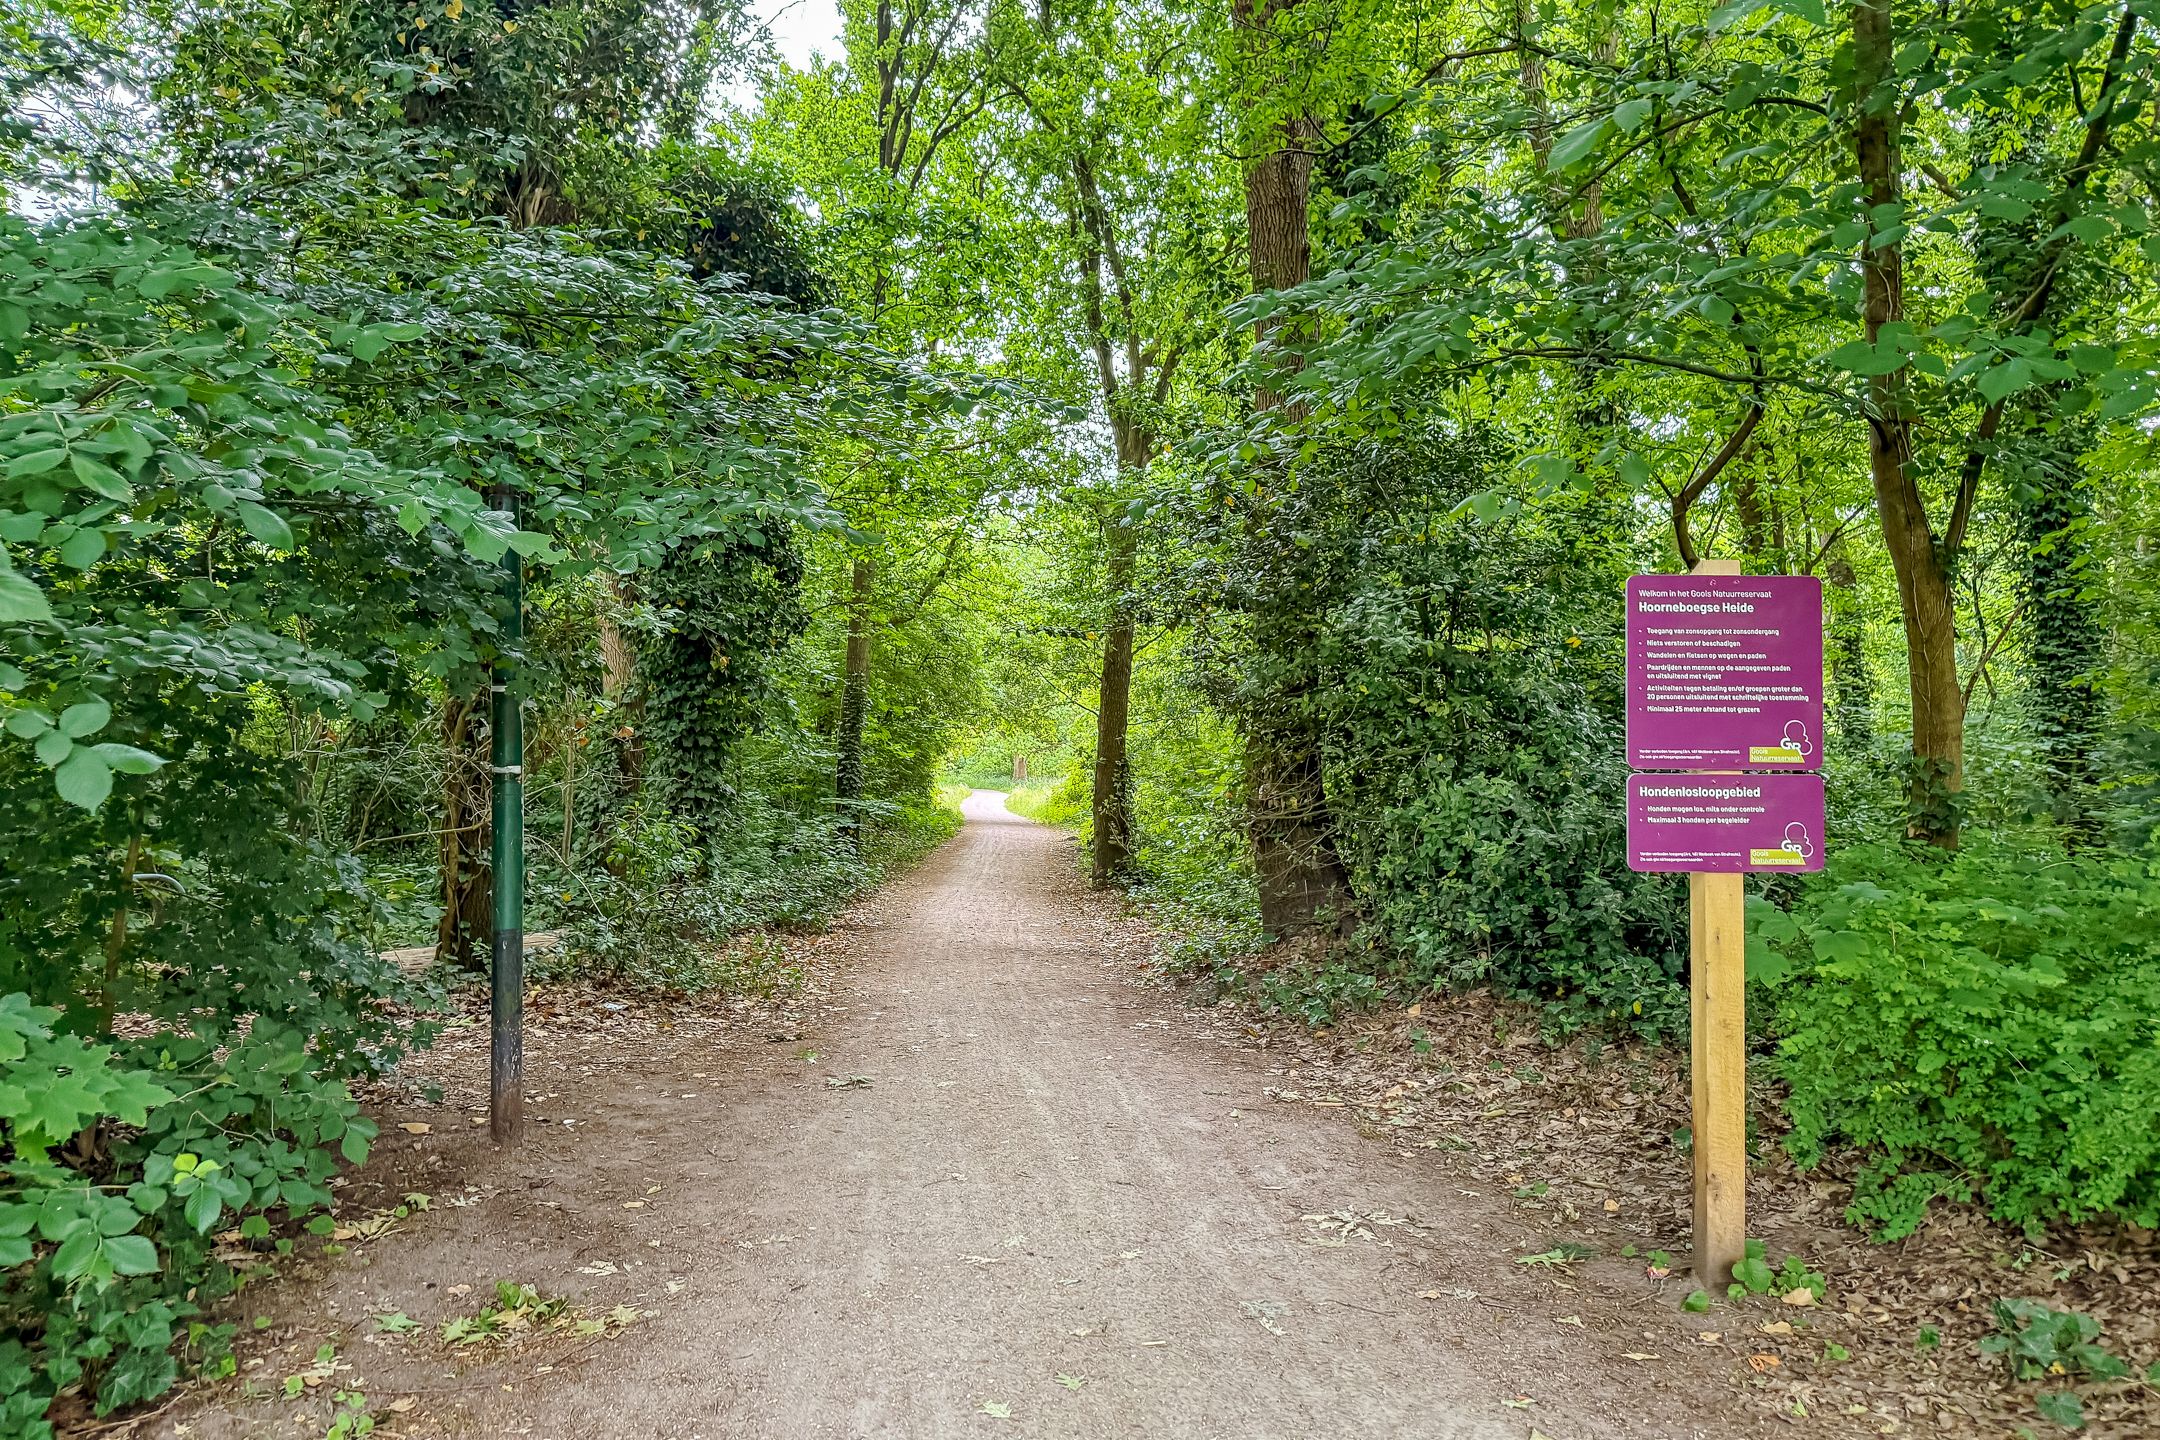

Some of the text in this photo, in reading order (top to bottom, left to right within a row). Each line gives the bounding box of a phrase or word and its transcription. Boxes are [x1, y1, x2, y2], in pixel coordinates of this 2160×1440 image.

[1639, 602, 1754, 614] Hoorneboegse Heide
[1639, 786, 1760, 799] Hondenlosloopgebied
